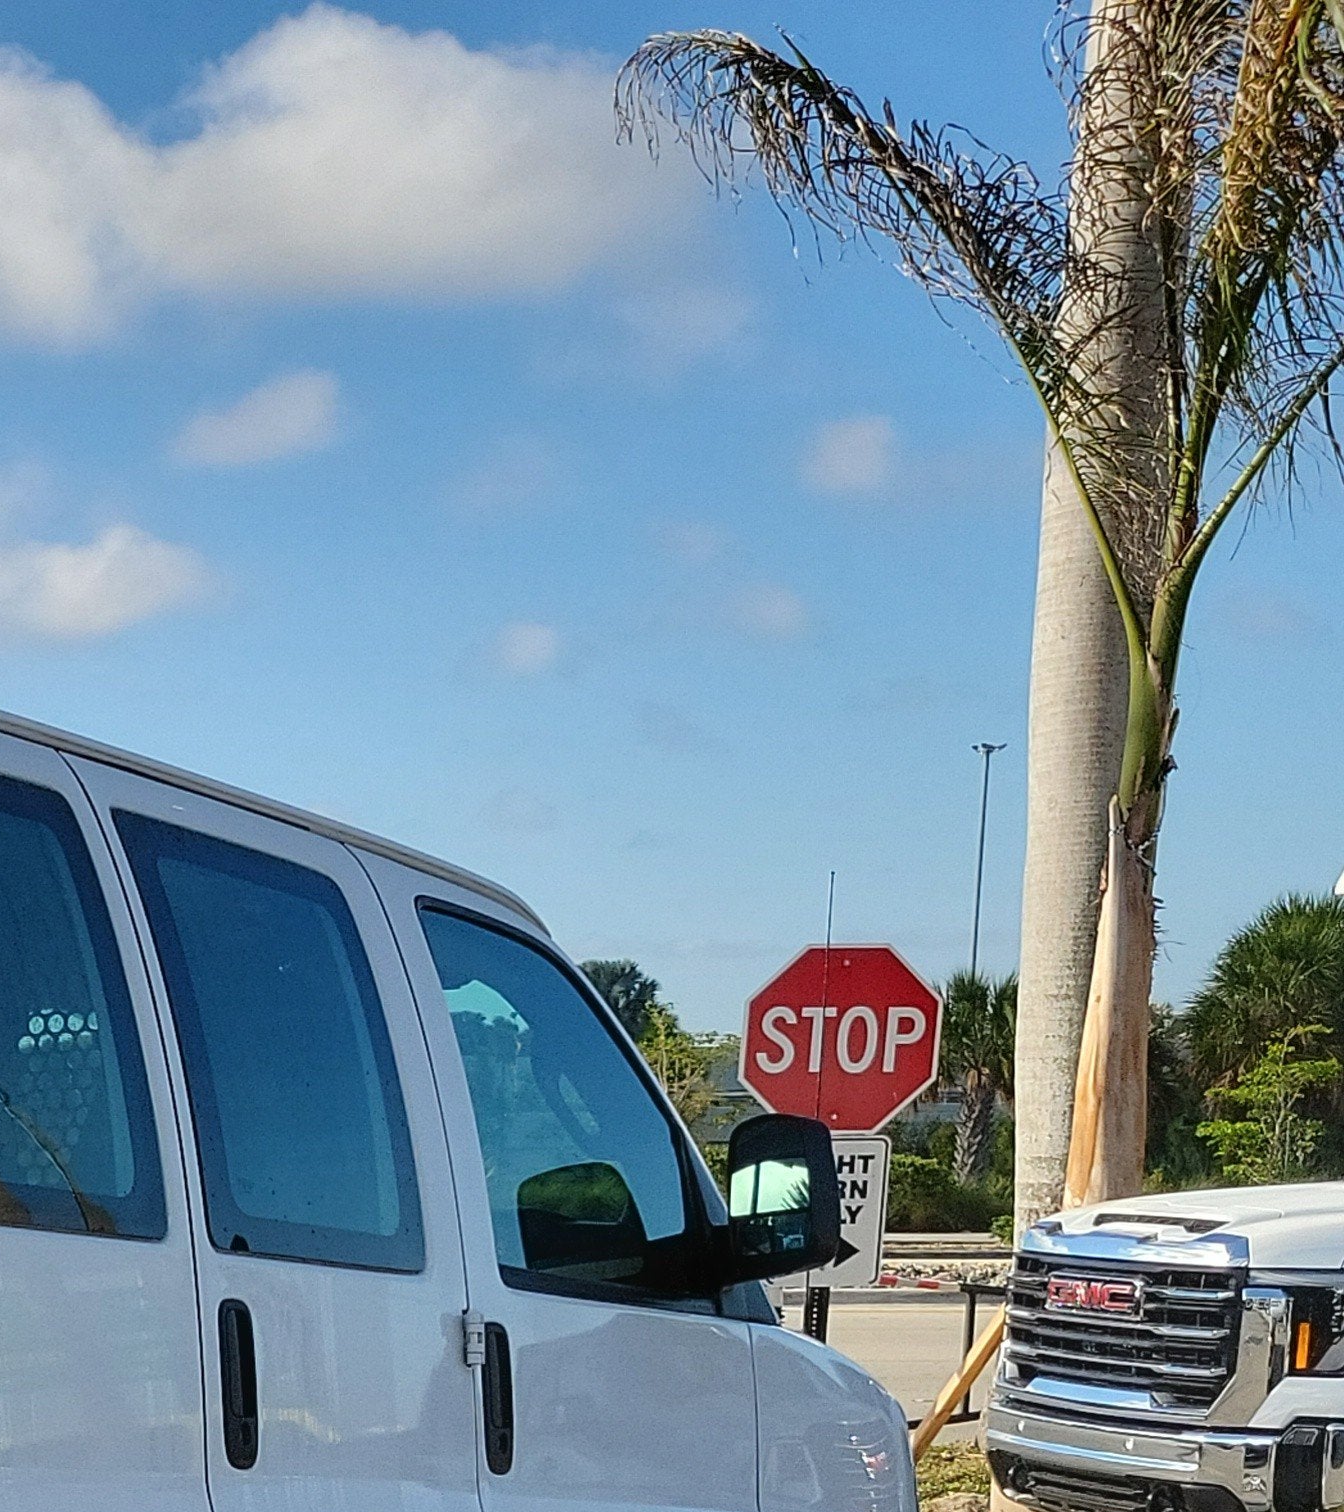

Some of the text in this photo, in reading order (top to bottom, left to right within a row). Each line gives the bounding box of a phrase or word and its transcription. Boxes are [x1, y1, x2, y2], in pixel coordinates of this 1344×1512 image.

[755, 1006, 927, 1074] STOP
[838, 1180, 868, 1199] RN
[1047, 1278, 1135, 1313] GMC
